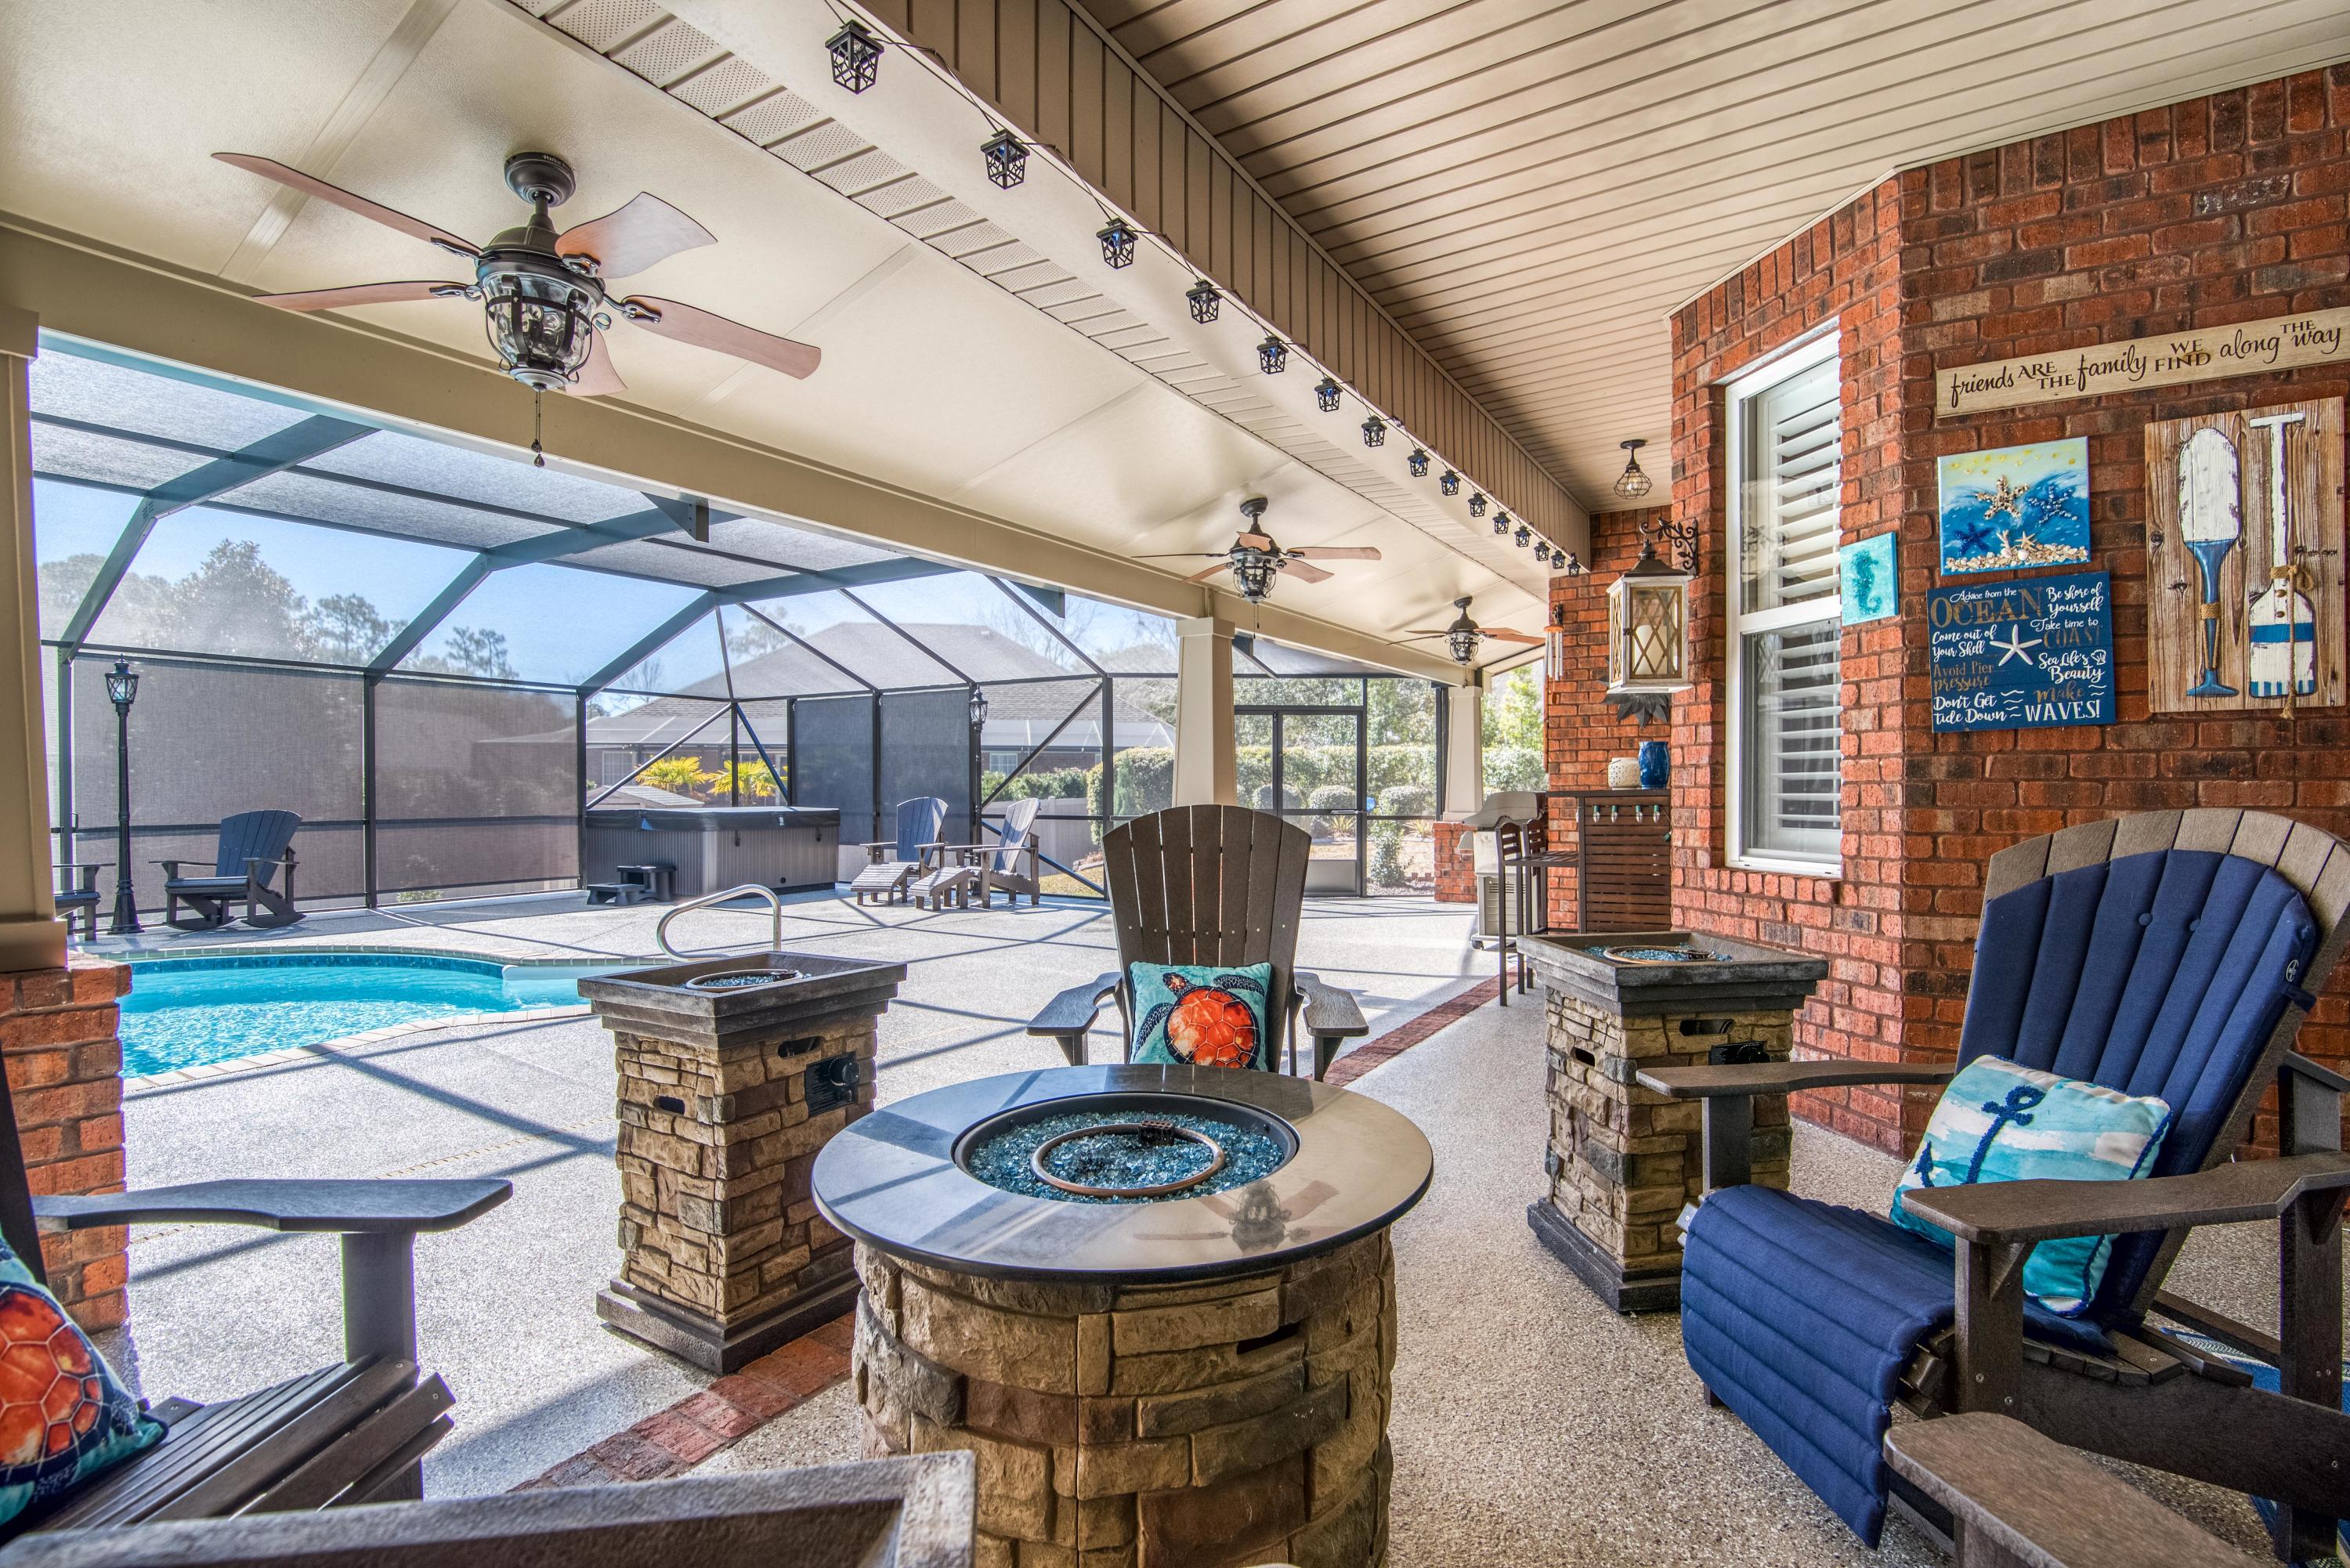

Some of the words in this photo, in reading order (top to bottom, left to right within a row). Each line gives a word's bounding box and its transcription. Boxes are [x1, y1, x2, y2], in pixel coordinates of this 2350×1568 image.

[2280, 320, 2316, 334] THE
[2170, 338, 2204, 354] WE
[1950, 365, 2015, 408] friends
[2077, 345, 2147, 392] family
[2220, 329, 2280, 363] along
[2290, 327, 2341, 354] way
[2018, 361, 2057, 379] ARE
[2155, 352, 2211, 372] FIND
[2037, 374, 2076, 389] THE
[1950, 590, 1983, 602] Advice
[2004, 587, 2017, 596] the
[2046, 587, 2063, 602] Be
[2064, 584, 2089, 600] shore
[2091, 582, 2102, 596] of
[1930, 587, 2043, 628] OCEAN
[2030, 618, 2061, 632] Take
[2064, 619, 2084, 629] time
[2088, 616, 2099, 627] to
[1932, 631, 1962, 645] Come
[1963, 629, 1982, 640] out
[1984, 624, 1998, 640] of
[2043, 624, 2102, 649] COAST
[1958, 640, 1986, 658] Shell
[2038, 652, 2060, 669] Sea
[2059, 650, 2090, 667] Life's
[1933, 663, 1965, 677] Avoid
[1972, 661, 1994, 674] Pier
[2048, 664, 2106, 684] Beauty
[1933, 675, 1991, 696] pressure
[1932, 695, 1971, 710] Don't
[1974, 692, 1998, 709] Get
[2024, 699, 2100, 721] WAVES!
[1932, 710, 1964, 725] tide
[1965, 708, 2008, 723] Down
